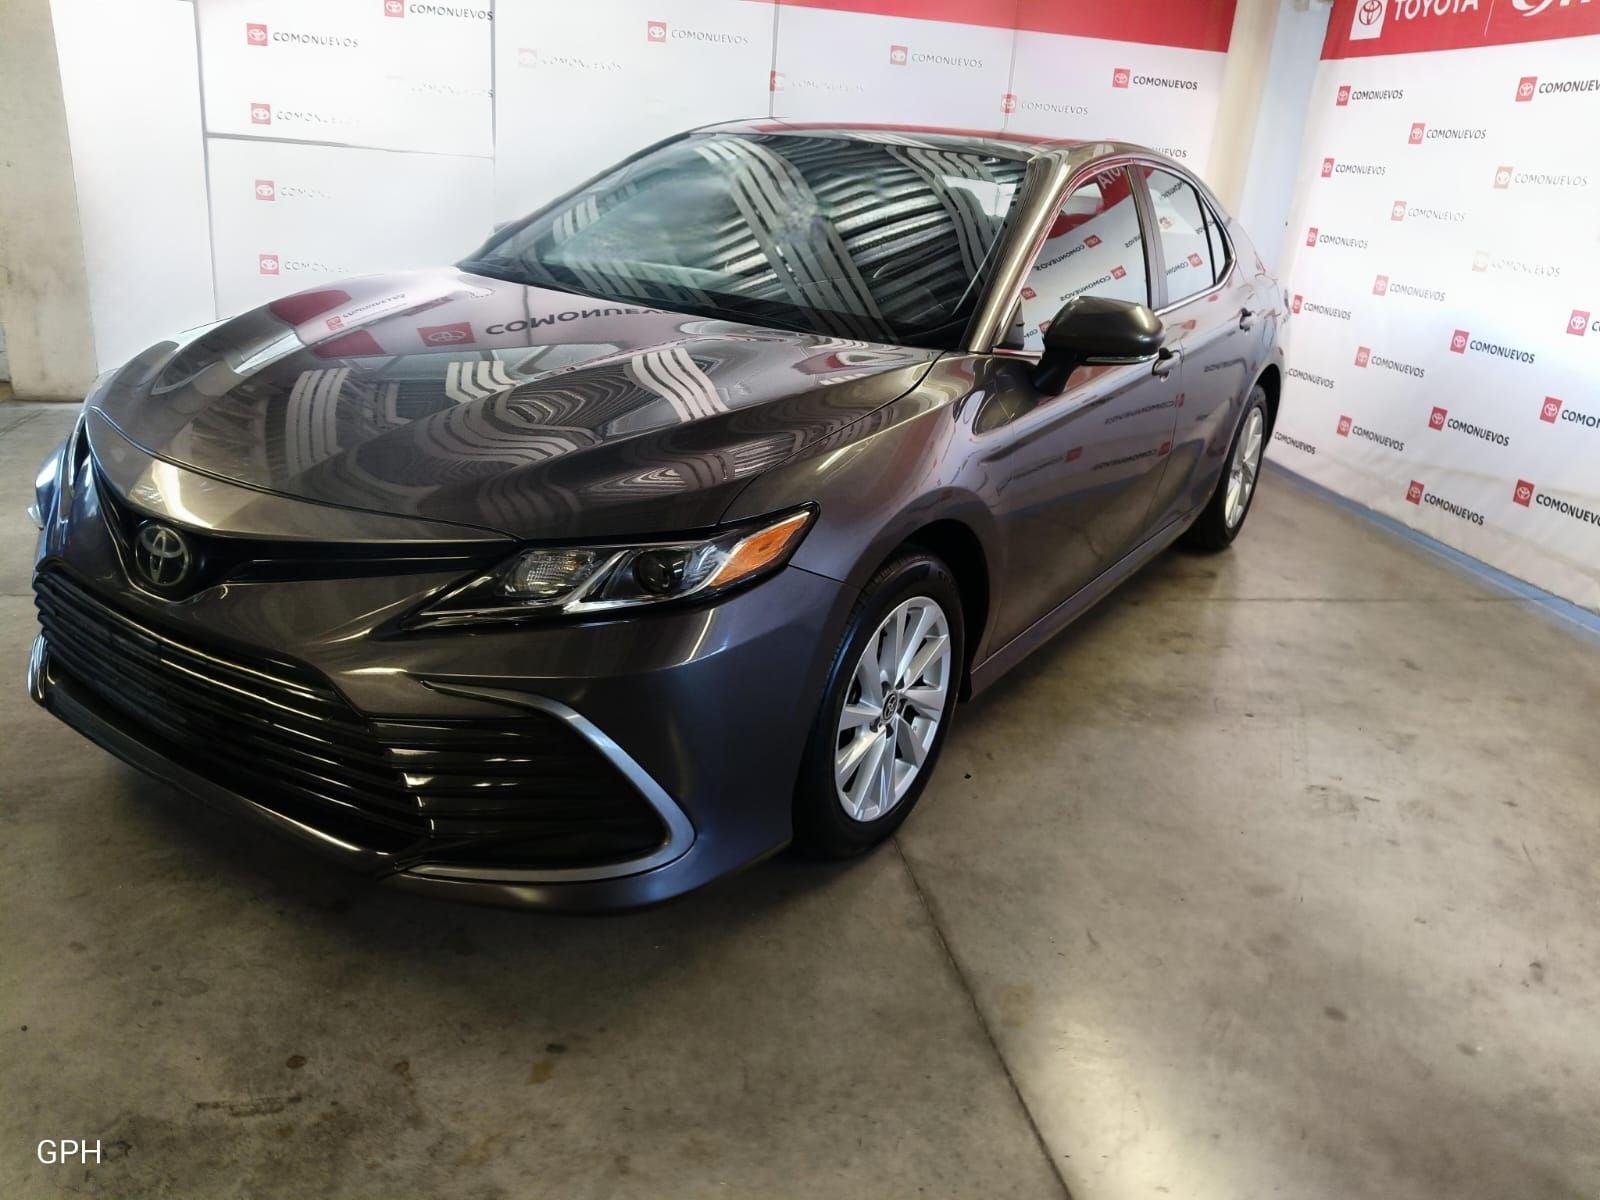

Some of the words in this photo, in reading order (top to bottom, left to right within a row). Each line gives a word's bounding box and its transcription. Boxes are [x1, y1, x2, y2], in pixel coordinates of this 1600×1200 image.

[409, 3, 494, 21] COMONUEVOS
[273, 31, 359, 48] COMONUEVOS
[671, 29, 750, 45] COMONUEVOS
[911, 52, 984, 68] COMONUEVOS
[1132, 75, 1199, 91] COMONUEVOS
[1352, 89, 1404, 101] COMONUEVOS
[1426, 129, 1487, 140] COMONUEVOS
[1335, 164, 1386, 176] COMONUEVOS
[1514, 172, 1588, 187] COMONUEVOS
[1408, 207, 1465, 222] COMONUEVOS
[1319, 234, 1368, 250] COMONUEVOS
[1390, 282, 1446, 302] COMONUEVOS
[1303, 301, 1352, 321] COMONUEVOS
[1469, 339, 1536, 364] COMONUEVOS
[1371, 354, 1425, 378] COMONUEVOS
[1288, 368, 1335, 389] COMONUEVOS
[1352, 425, 1405, 452] COMONUEVOS
[1447, 417, 1510, 447] COMONUEVOS
[1274, 431, 1316, 455] COMONUEVOS
[1424, 492, 1485, 526] COMONUEVOS
